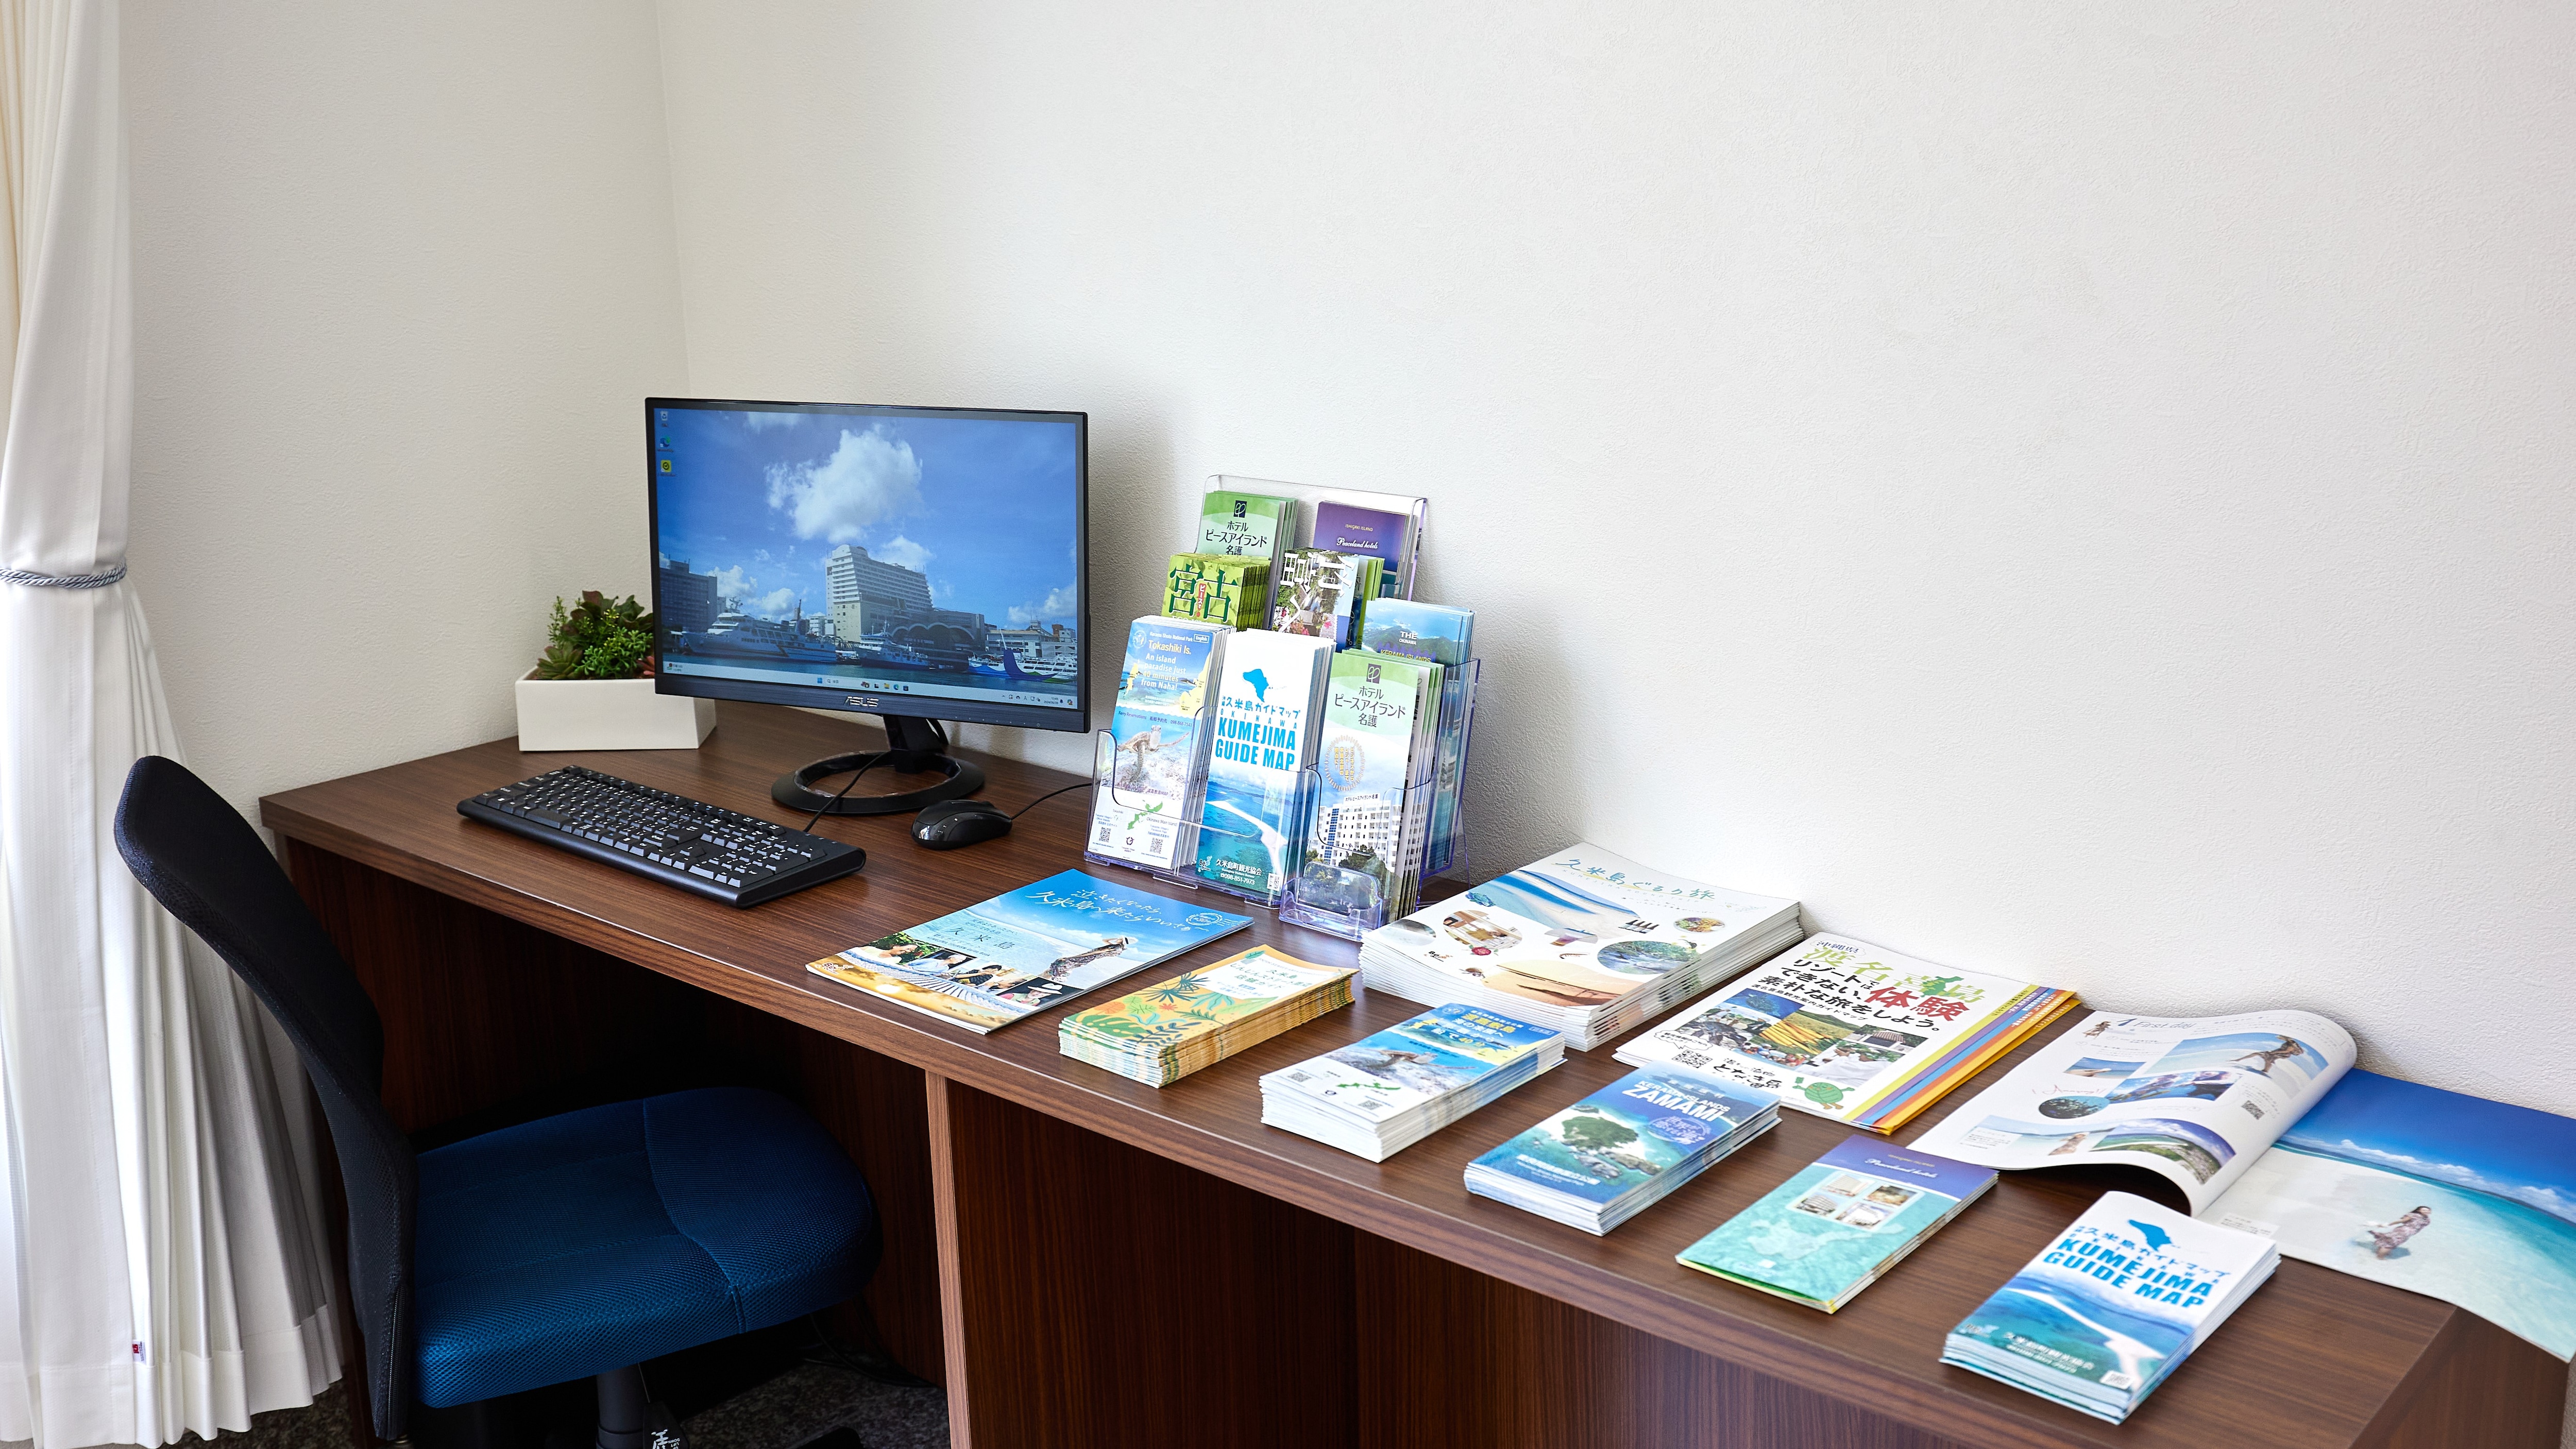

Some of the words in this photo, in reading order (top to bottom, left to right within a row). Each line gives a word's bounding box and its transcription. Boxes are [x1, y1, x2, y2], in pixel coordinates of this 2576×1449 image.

[1227, 521, 1249, 532] ホテル
[1206, 529, 1267, 548] ピースアイランド
[1336, 537, 1365, 548] Peaceland
[1364, 541, 1378, 549] hotels
[1168, 563, 1239, 623] 宮古
[1400, 631, 1417, 640] THE
[1148, 639, 1182, 653] Tokashiki
[1145, 653, 1155, 661] An
[1156, 654, 1176, 664] island
[1144, 662, 1173, 673] paradise
[1174, 666, 1187, 675] just
[1151, 672, 1179, 682] minutes
[1141, 679, 1157, 687] from
[1158, 681, 1178, 690] Naha!
[1359, 686, 1384, 700] ホテル
[844, 696, 879, 707] ASUS
[1226, 696, 1301, 719] 久米島ガイドマップ
[1335, 693, 1405, 719] ピースアイランド
[1358, 712, 1378, 727] 名護
[1218, 717, 1295, 751] KUMEJIMA
[1215, 739, 1259, 765] GUIDE
[1262, 748, 1295, 771] MAP
[1216, 858, 1262, 876] 久米島町観光協会
[1555, 859, 1716, 900] 久米島ぐるり旅
[1563, 870, 1620, 889] KUMEJIMA
[944, 927, 1015, 949] 久米島
[1816, 941, 1860, 953] 沖縄県
[1802, 946, 1985, 1003] 渡名喜島
[1751, 984, 1869, 1020] 渡名喜島観光案内ガイドマップ
[1758, 976, 1940, 1031] 素朴な旅をしよう。
[1864, 986, 1970, 1021] 体験
[1622, 1084, 1725, 1122] ZAMAMI
[1684, 1095, 1731, 1112] ISLANDS
[2084, 1227, 2232, 1277] 久米島ガイドマップ
[2056, 1238, 2213, 1297] KUMEJIMA
[2042, 1252, 2132, 1289] GUIDE
[2134, 1283, 2205, 1308] MAP
